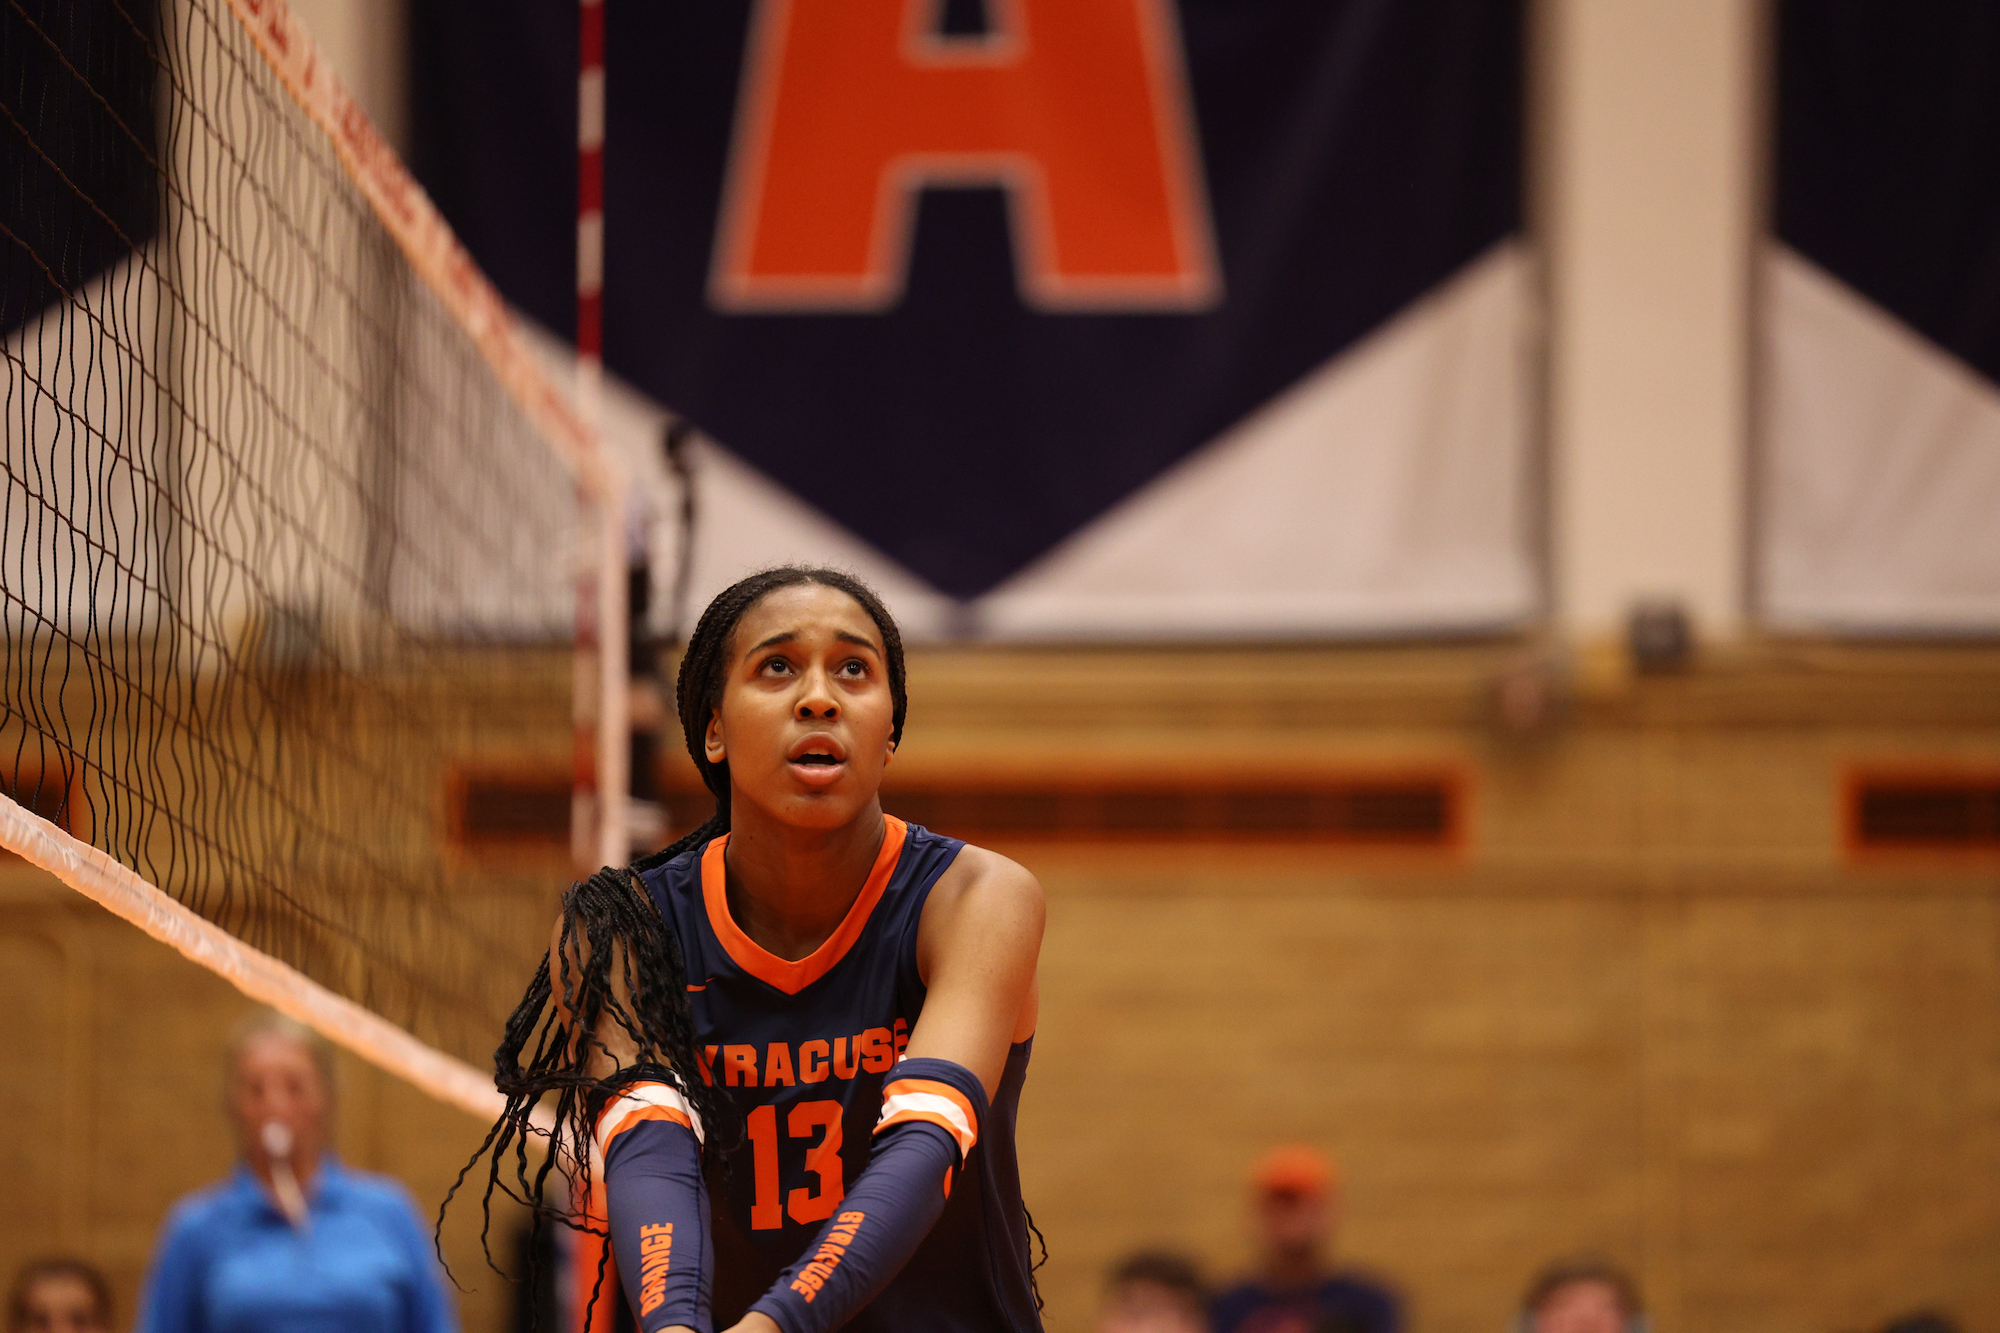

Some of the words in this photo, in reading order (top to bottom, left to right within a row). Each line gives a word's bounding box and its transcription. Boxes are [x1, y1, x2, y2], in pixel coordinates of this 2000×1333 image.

[691, 1017, 910, 1087] YRACUSE
[746, 1099, 846, 1230] 13
[639, 1222, 674, 1318] ORANGE
[790, 1210, 865, 1303] SYRACUSE
